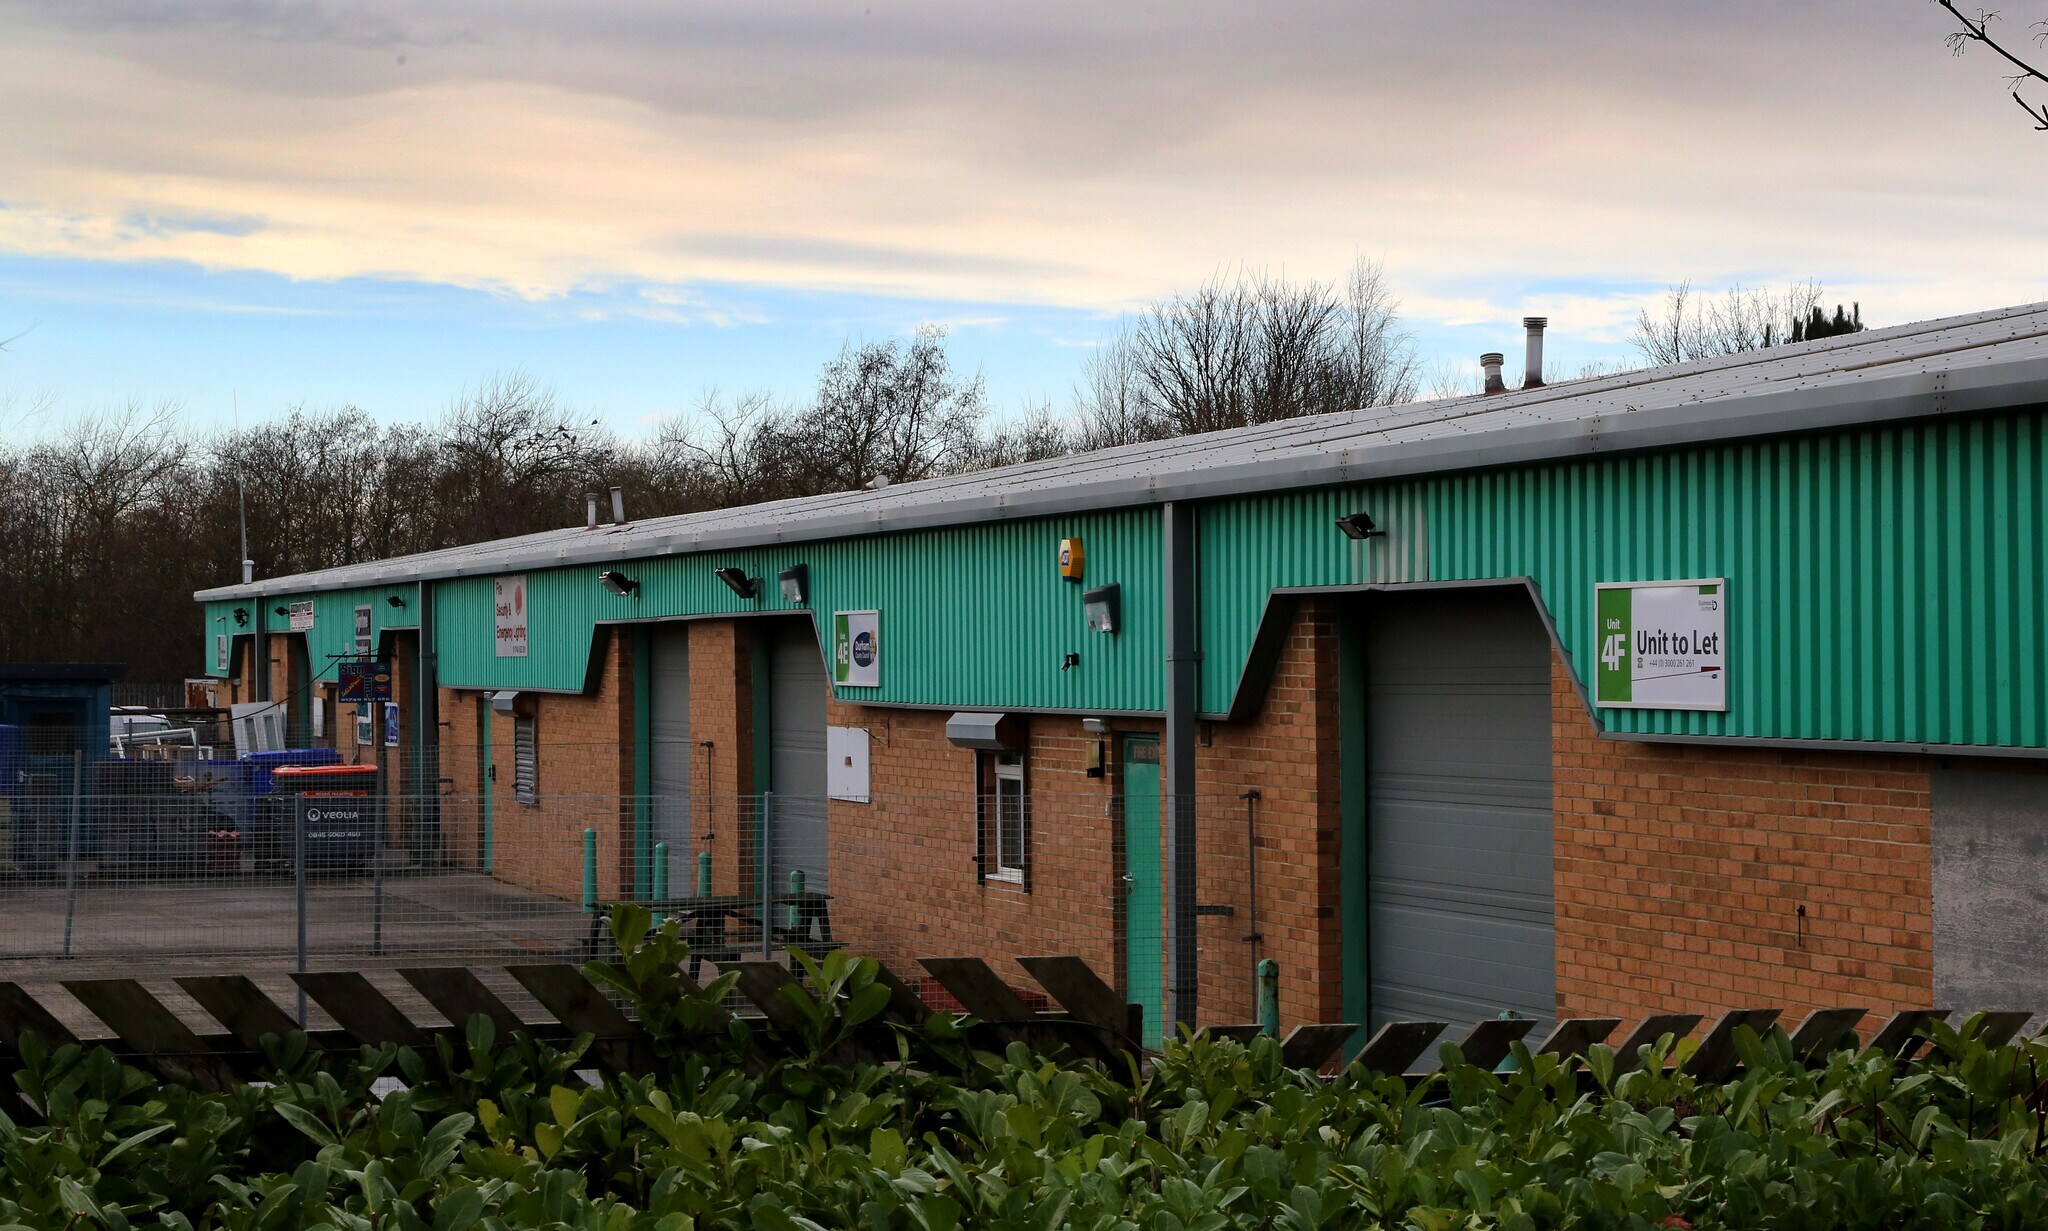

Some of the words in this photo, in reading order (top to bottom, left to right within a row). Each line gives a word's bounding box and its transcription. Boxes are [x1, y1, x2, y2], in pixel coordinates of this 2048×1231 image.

[1607, 618, 1620, 630] Unit
[855, 640, 869, 651] Durham
[1637, 629, 1668, 655] Unit
[1672, 632, 1688, 655] to
[1693, 630, 1718, 655] Let
[837, 642, 848, 664] 4E
[1601, 634, 1625, 671] 4F
[1649, 659, 1657, 667] +44
[1664, 659, 1676, 668] 3000
[1677, 659, 1685, 667] 261
[1686, 659, 1695, 667] 261
[341, 664, 364, 676] Sign
[323, 811, 359, 819] VEOLIA
